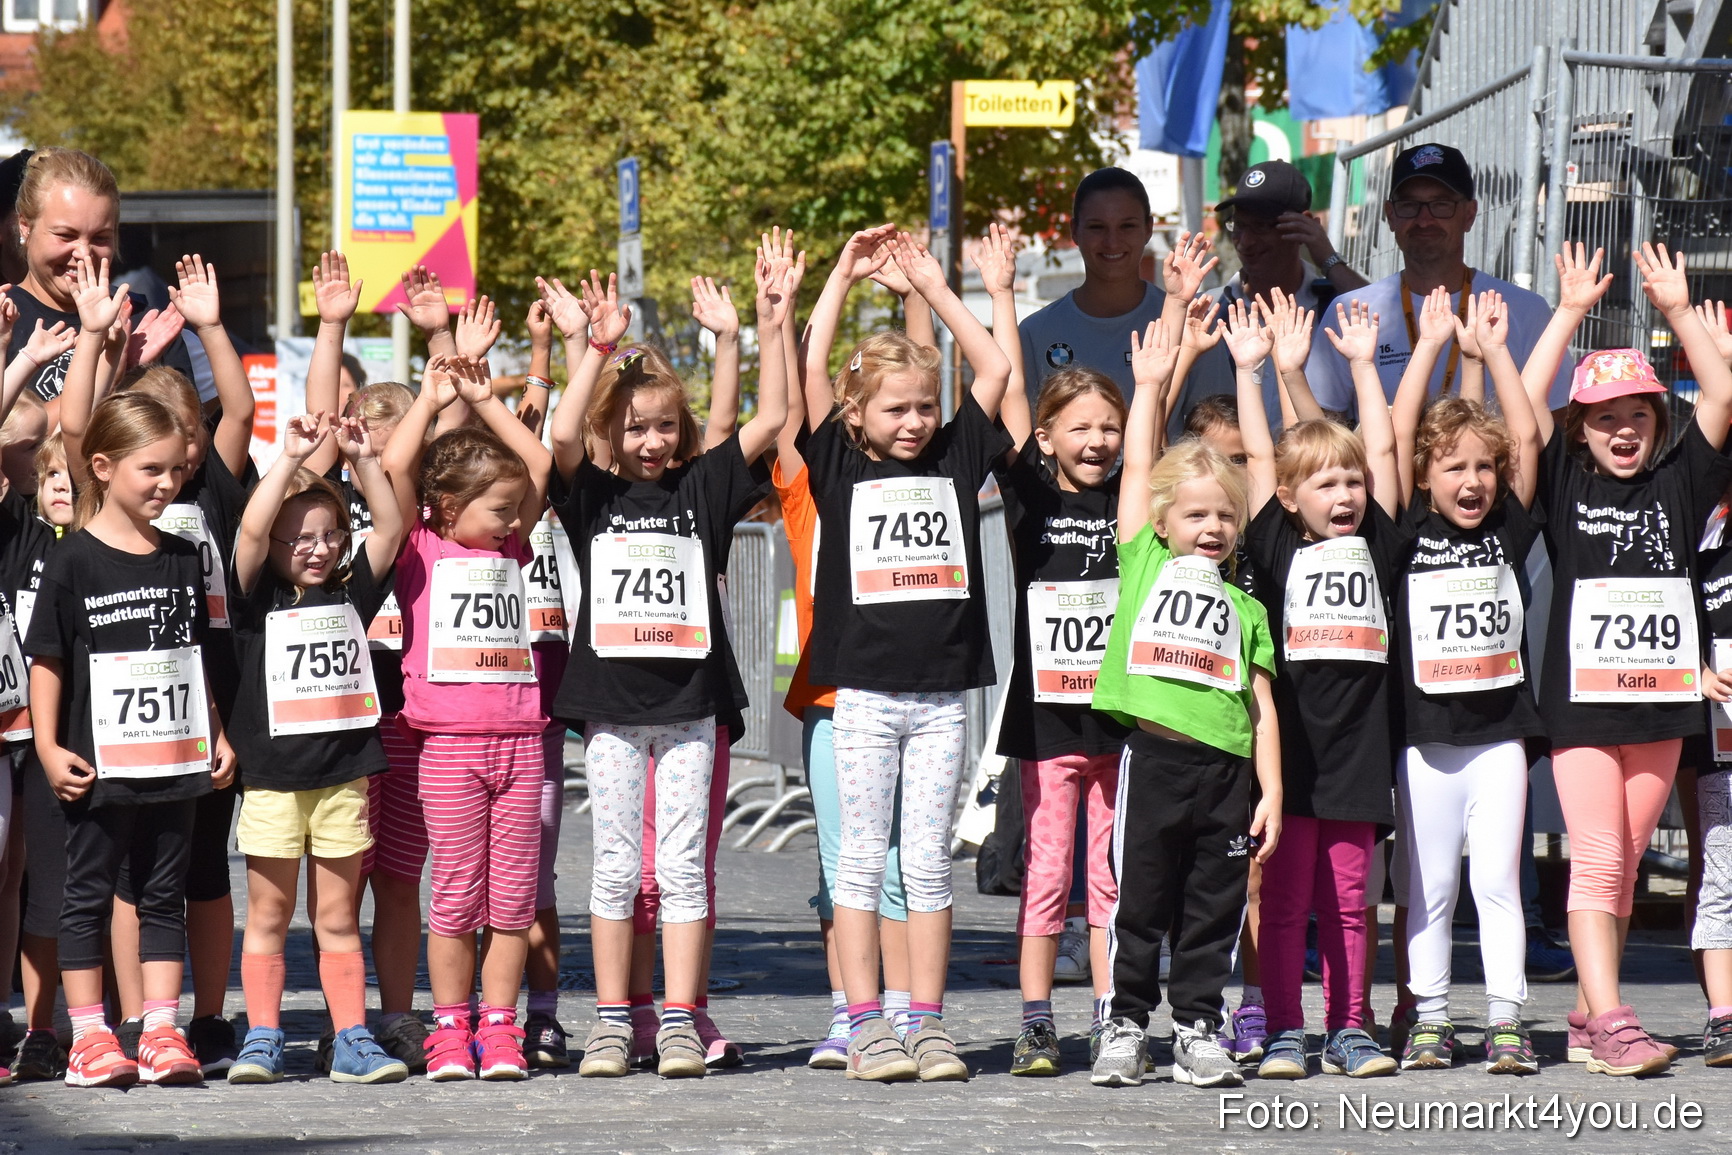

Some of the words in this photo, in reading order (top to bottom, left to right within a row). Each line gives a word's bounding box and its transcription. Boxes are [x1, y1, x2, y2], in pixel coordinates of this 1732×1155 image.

[967, 95, 1053, 112] Toiletten
[934, 154, 945, 218] P
[621, 168, 634, 224] P
[1378, 344, 1394, 354] 16.
[883, 489, 933, 503] BOCK
[868, 511, 951, 550] 7432
[1045, 517, 1109, 531] Neumarkte
[1040, 531, 1099, 550] Stadtlauf
[628, 545, 676, 559] BOCK
[905, 554, 940, 562] Neumarkt
[1322, 548, 1369, 561] BOCK
[469, 569, 507, 582] BOCK
[892, 572, 938, 587] Emma
[1174, 567, 1220, 587] BOCK
[611, 568, 686, 606] 7431
[1305, 571, 1376, 609] 7501
[1447, 577, 1498, 592] BOCK
[84, 587, 168, 610] Neumarkter
[1058, 592, 1106, 606] BOCK
[1608, 591, 1664, 603] BOCK
[89, 604, 155, 628] Stadtlauf
[451, 593, 520, 629] 7500
[645, 611, 679, 619] Neumarkt
[1152, 589, 1230, 636] 7073
[1338, 613, 1370, 622] Neumarkt
[301, 616, 347, 632] BOCK
[1430, 600, 1511, 640] 7535
[485, 635, 513, 643] Neumarkt
[634, 627, 674, 642] Luise
[1153, 630, 1176, 639] PARTL
[1178, 633, 1213, 647] Neumarkt
[1294, 629, 1354, 643] ISABELLA
[1590, 614, 1681, 650] 7349
[1471, 643, 1499, 652] Neumarkt
[286, 638, 361, 680] 7552
[475, 652, 508, 667] Julia
[1153, 646, 1214, 672] Mathilda
[1628, 656, 1664, 664] Neumarkt
[131, 660, 179, 676] BOCK
[1432, 664, 1482, 678] HELENA
[296, 685, 323, 693] PARTL
[325, 683, 353, 692] Neumarkt
[1617, 673, 1657, 688] Karla
[113, 683, 190, 724] 7517
[123, 730, 150, 738] PARTL
[153, 728, 183, 737] Neumarkt
